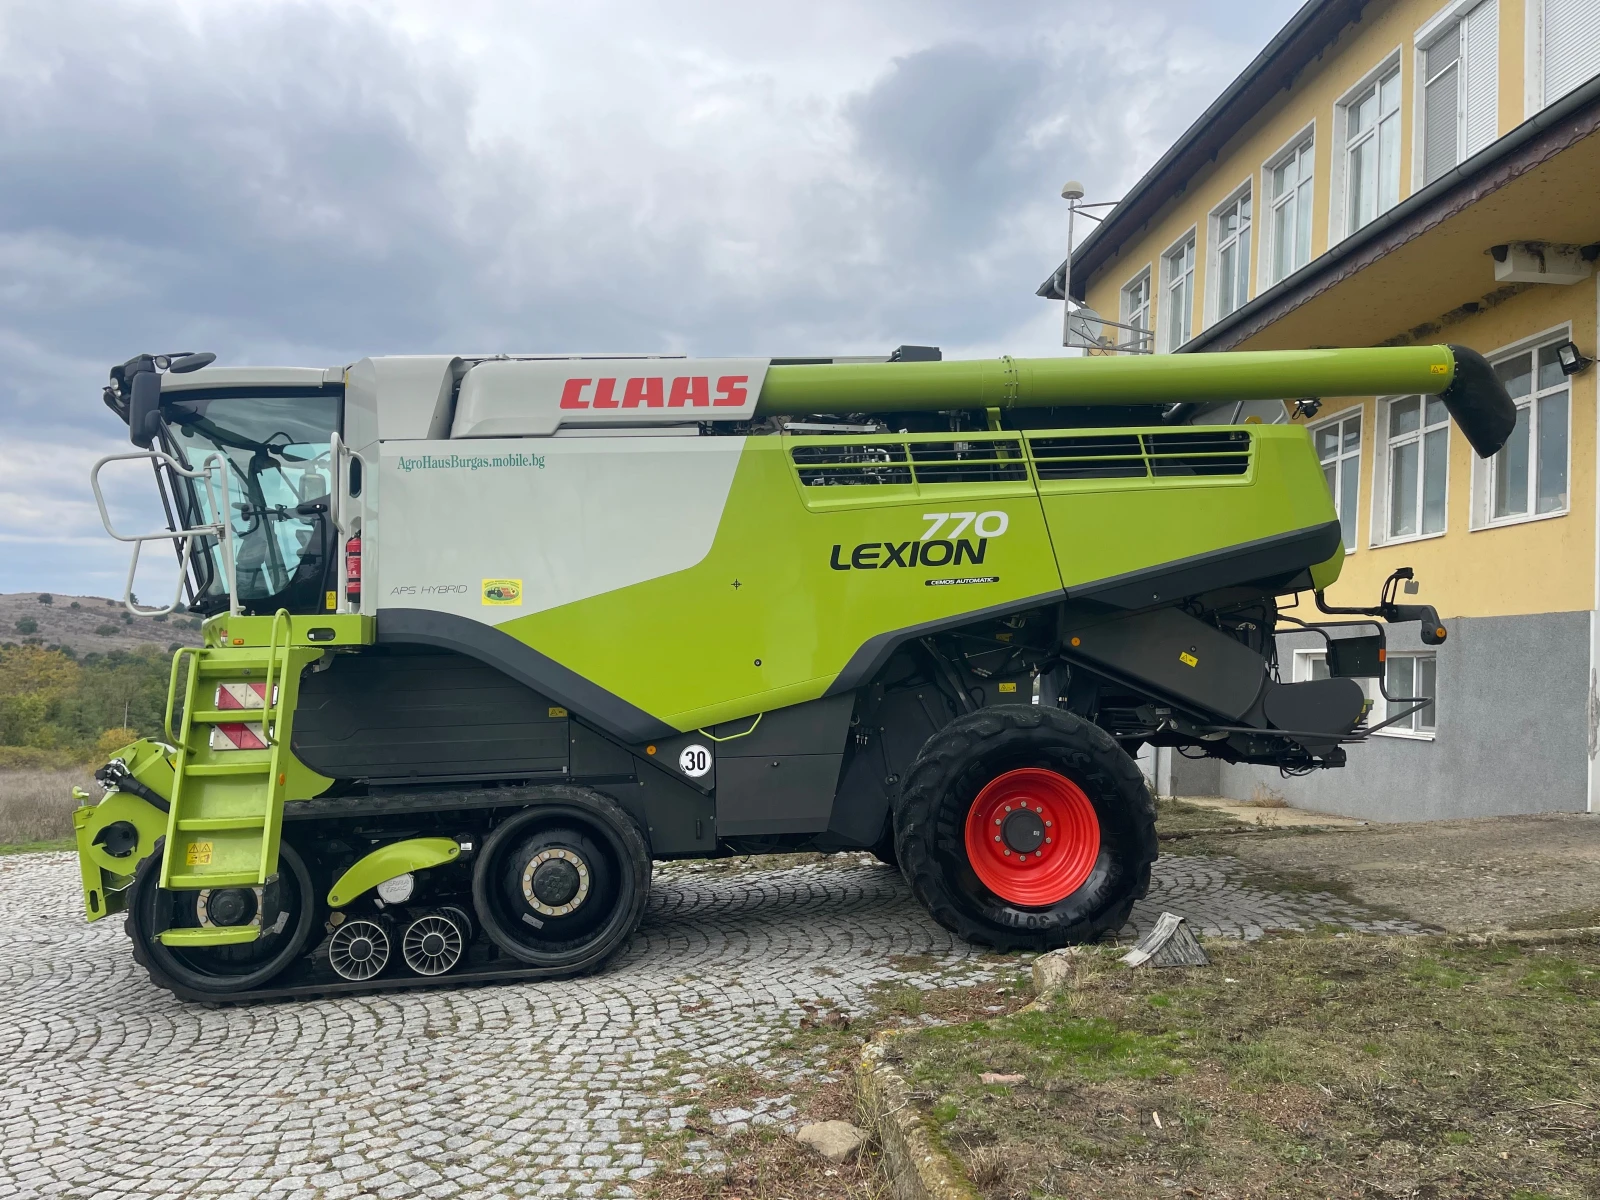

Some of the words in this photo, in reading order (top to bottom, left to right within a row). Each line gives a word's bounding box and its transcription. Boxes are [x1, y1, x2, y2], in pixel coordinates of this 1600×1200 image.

[559, 375, 749, 409] CLAAS
[397, 453, 545, 472] AgroHausBurgas.mobile.bg
[919, 510, 1009, 541] 770
[829, 538, 988, 571] LEXION
[389, 586, 417, 596] APS
[420, 584, 468, 595] HYBRID
[685, 750, 706, 771] 30
[1027, 916, 1050, 930] 30
